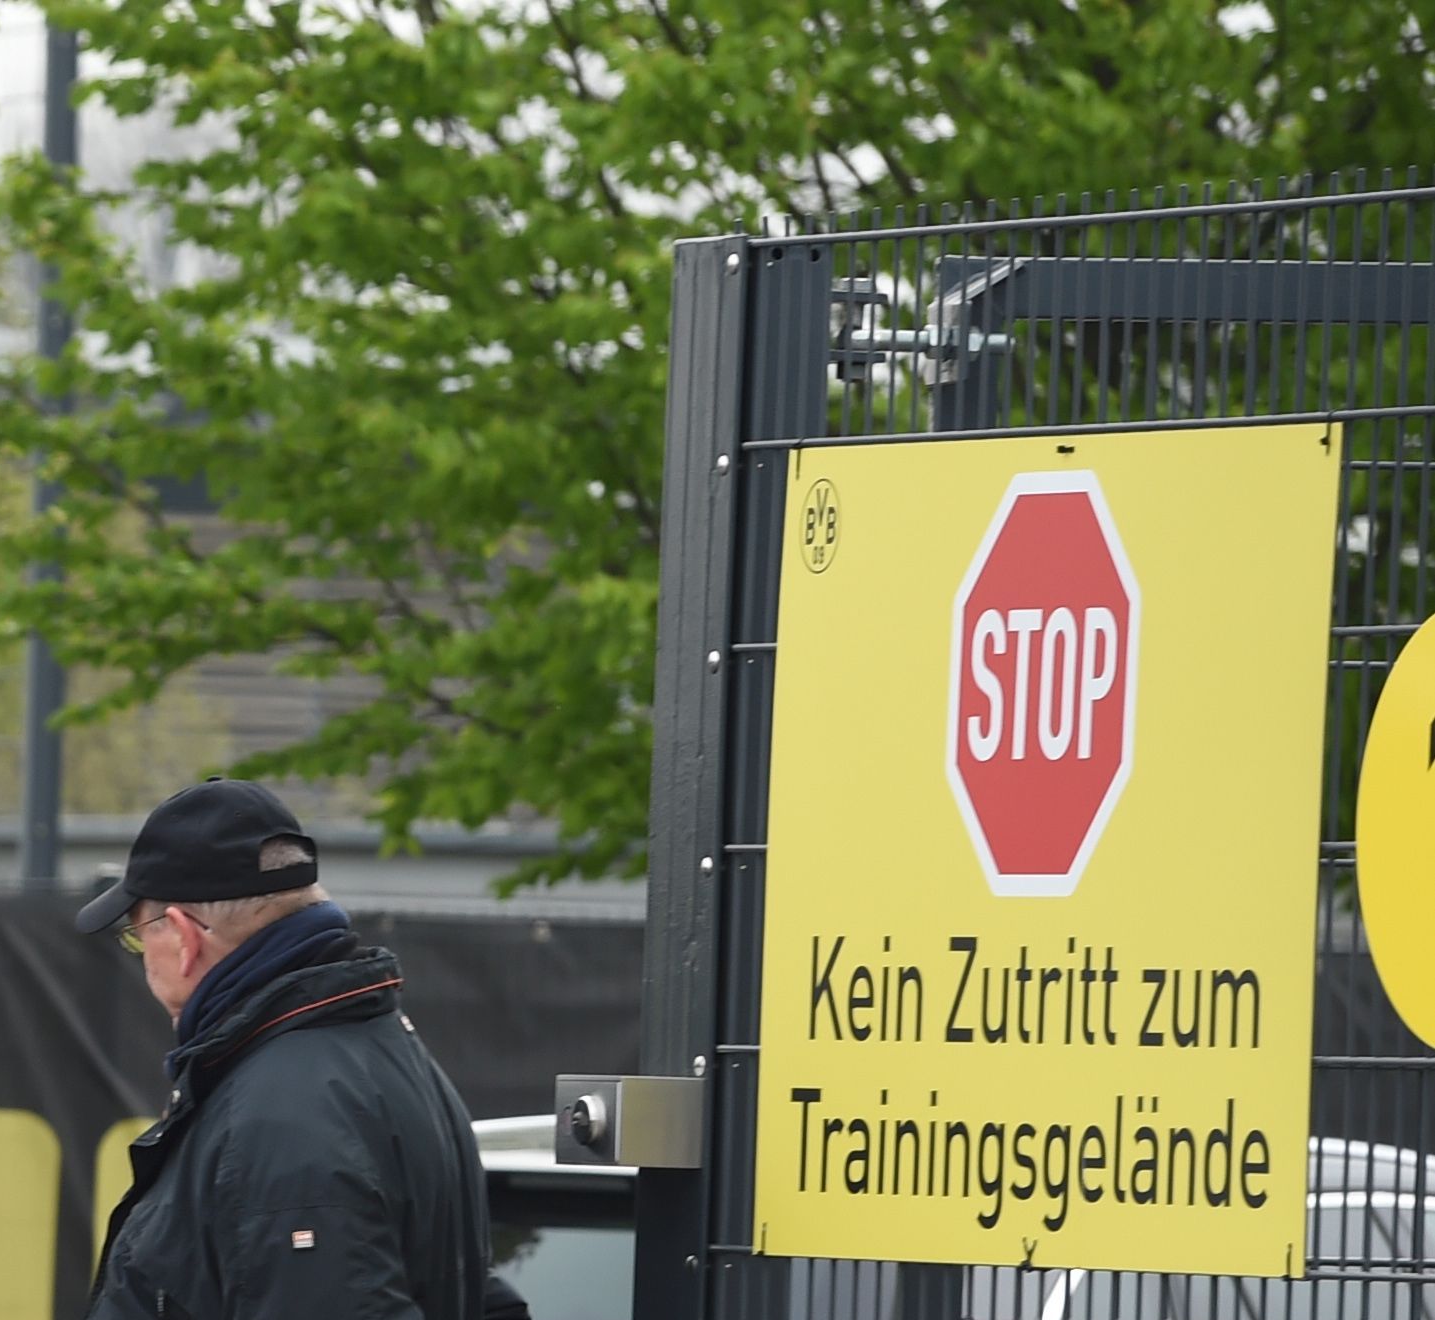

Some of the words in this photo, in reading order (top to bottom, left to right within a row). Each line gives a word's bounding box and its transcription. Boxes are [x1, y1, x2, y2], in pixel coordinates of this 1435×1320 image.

[805, 488, 836, 545] BVB
[967, 606, 1118, 762] STOP
[808, 935, 923, 1043] Kein
[944, 936, 1119, 1046] Zutritt
[1139, 967, 1262, 1049] zum
[790, 1088, 1271, 1231] Trainingsgelände
